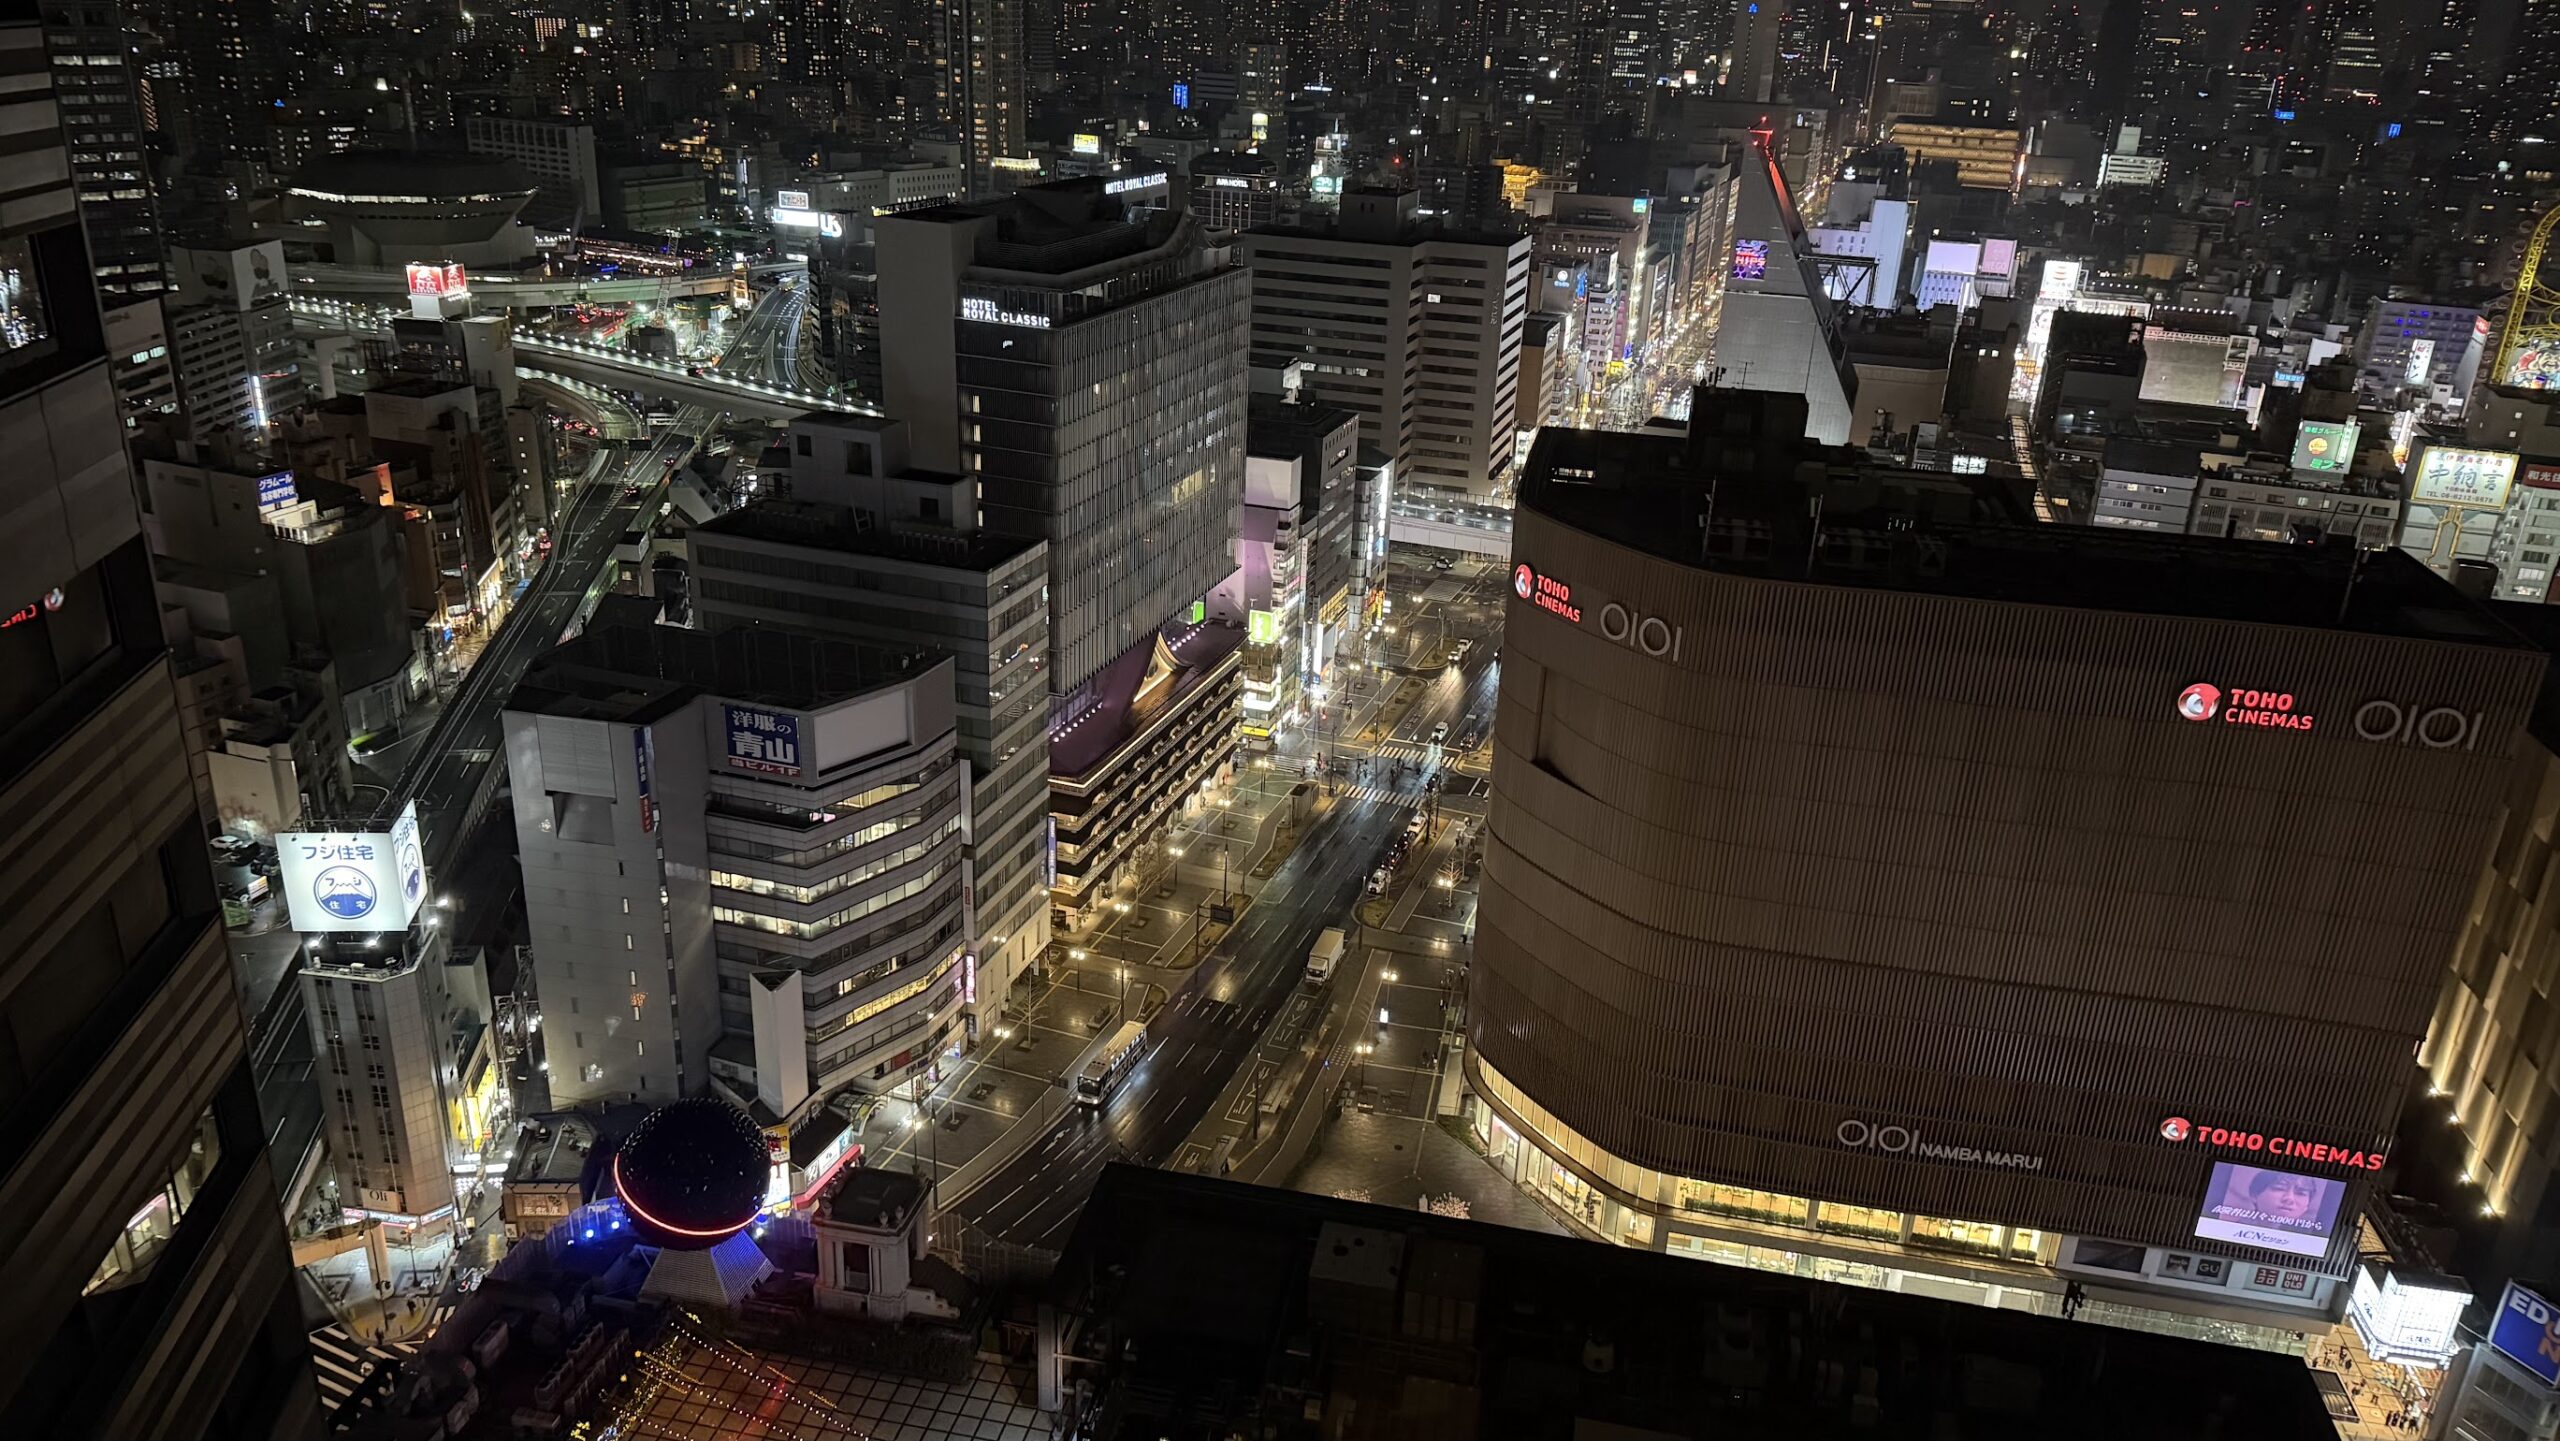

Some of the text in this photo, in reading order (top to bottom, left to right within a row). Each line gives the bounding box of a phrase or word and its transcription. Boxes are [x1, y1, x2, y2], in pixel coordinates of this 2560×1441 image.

[963, 298, 998, 312] HOTEL
[963, 308, 1050, 327] ROYAL CLASSIC
[259, 474, 293, 490] グラムール
[1536, 574, 1569, 601] TOHO
[1534, 591, 1581, 623] CINEMAS
[2230, 688, 2293, 711] TOHO
[732, 709, 792, 735] 洋服の
[2225, 708, 2314, 730] CINEMAS
[732, 730, 795, 764] 青山
[730, 758, 799, 776] 当ビル1F
[301, 845, 374, 861] フジ住宅
[1919, 1142, 1982, 1163] NAMBA
[1985, 1150, 2043, 1170] MARUI
[2198, 1126, 2384, 1171] TOHO CINEMAS
[2199, 1263, 2220, 1274] GU
[2286, 1273, 2304, 1282] UNI
[2283, 1281, 2303, 1290] QLO
